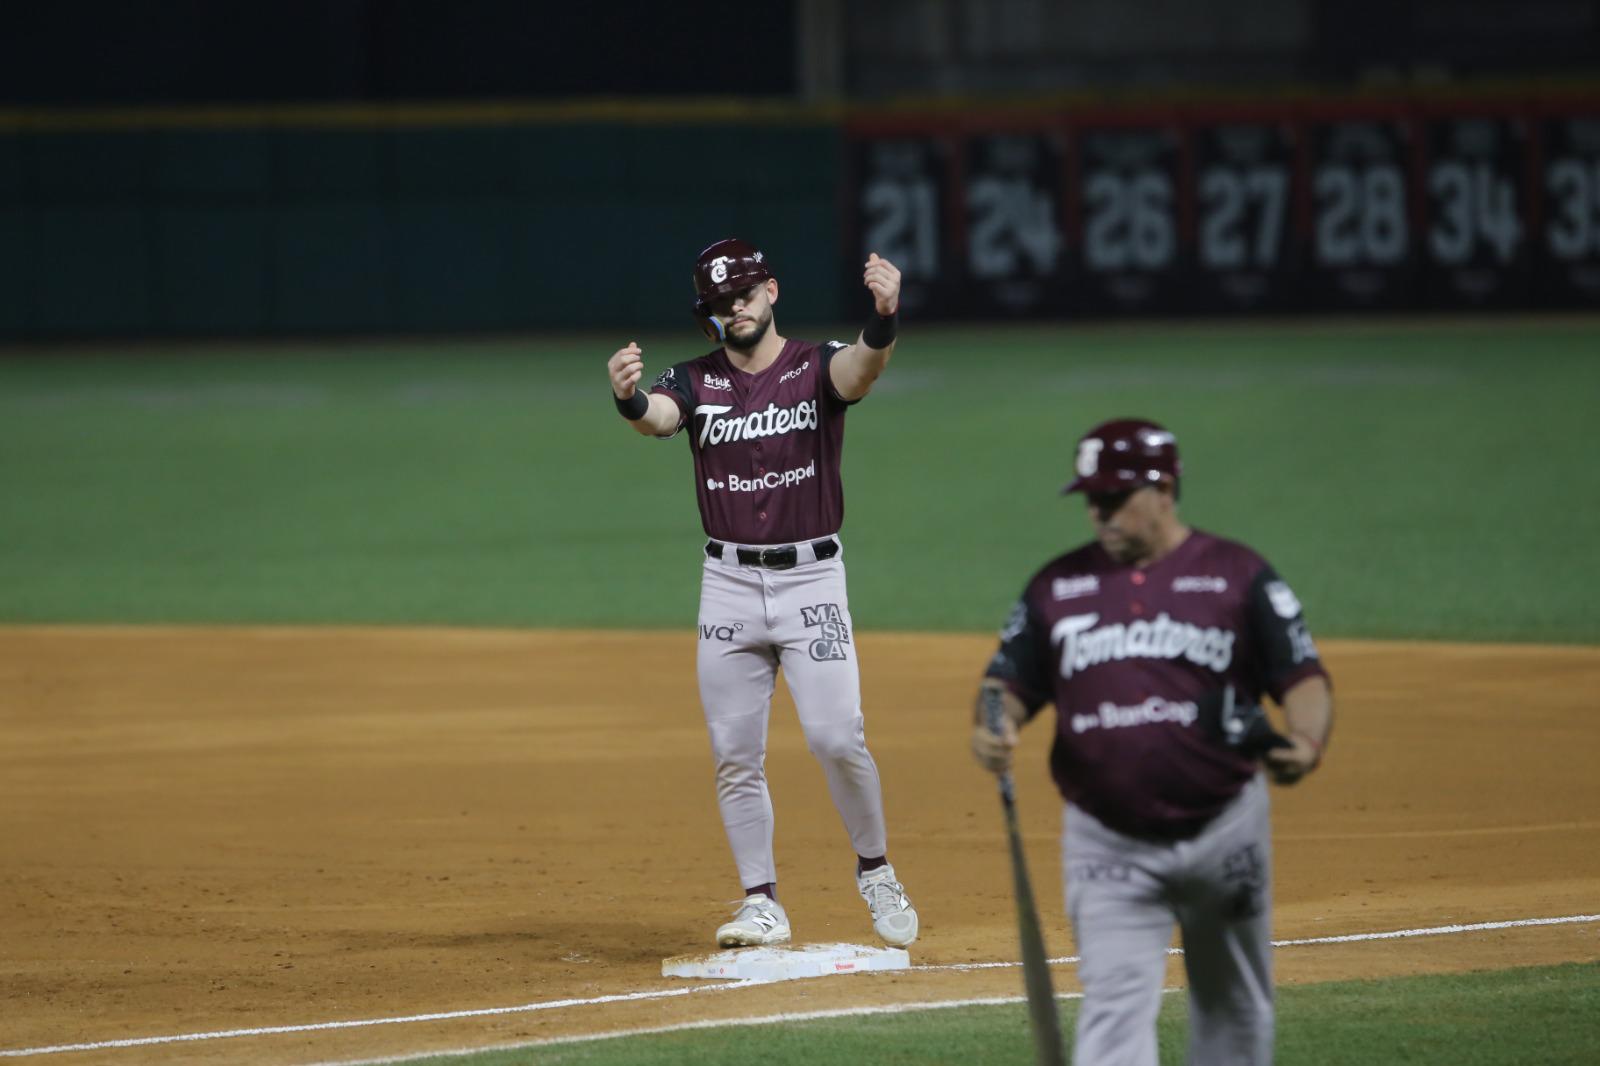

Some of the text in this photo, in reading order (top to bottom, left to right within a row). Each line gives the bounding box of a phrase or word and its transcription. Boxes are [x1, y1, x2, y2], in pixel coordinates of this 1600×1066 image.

[864, 182, 938, 277] 21
[967, 180, 1061, 277] 24
[1083, 171, 1175, 270] 26
[1199, 168, 1288, 268] 27
[1313, 167, 1409, 266] 28
[1429, 162, 1522, 266] 34
[1547, 160, 1600, 261] 3
[695, 399, 818, 449] Tomateros
[728, 459, 815, 492] BanCoppel
[1051, 612, 1235, 679] Tomateros
